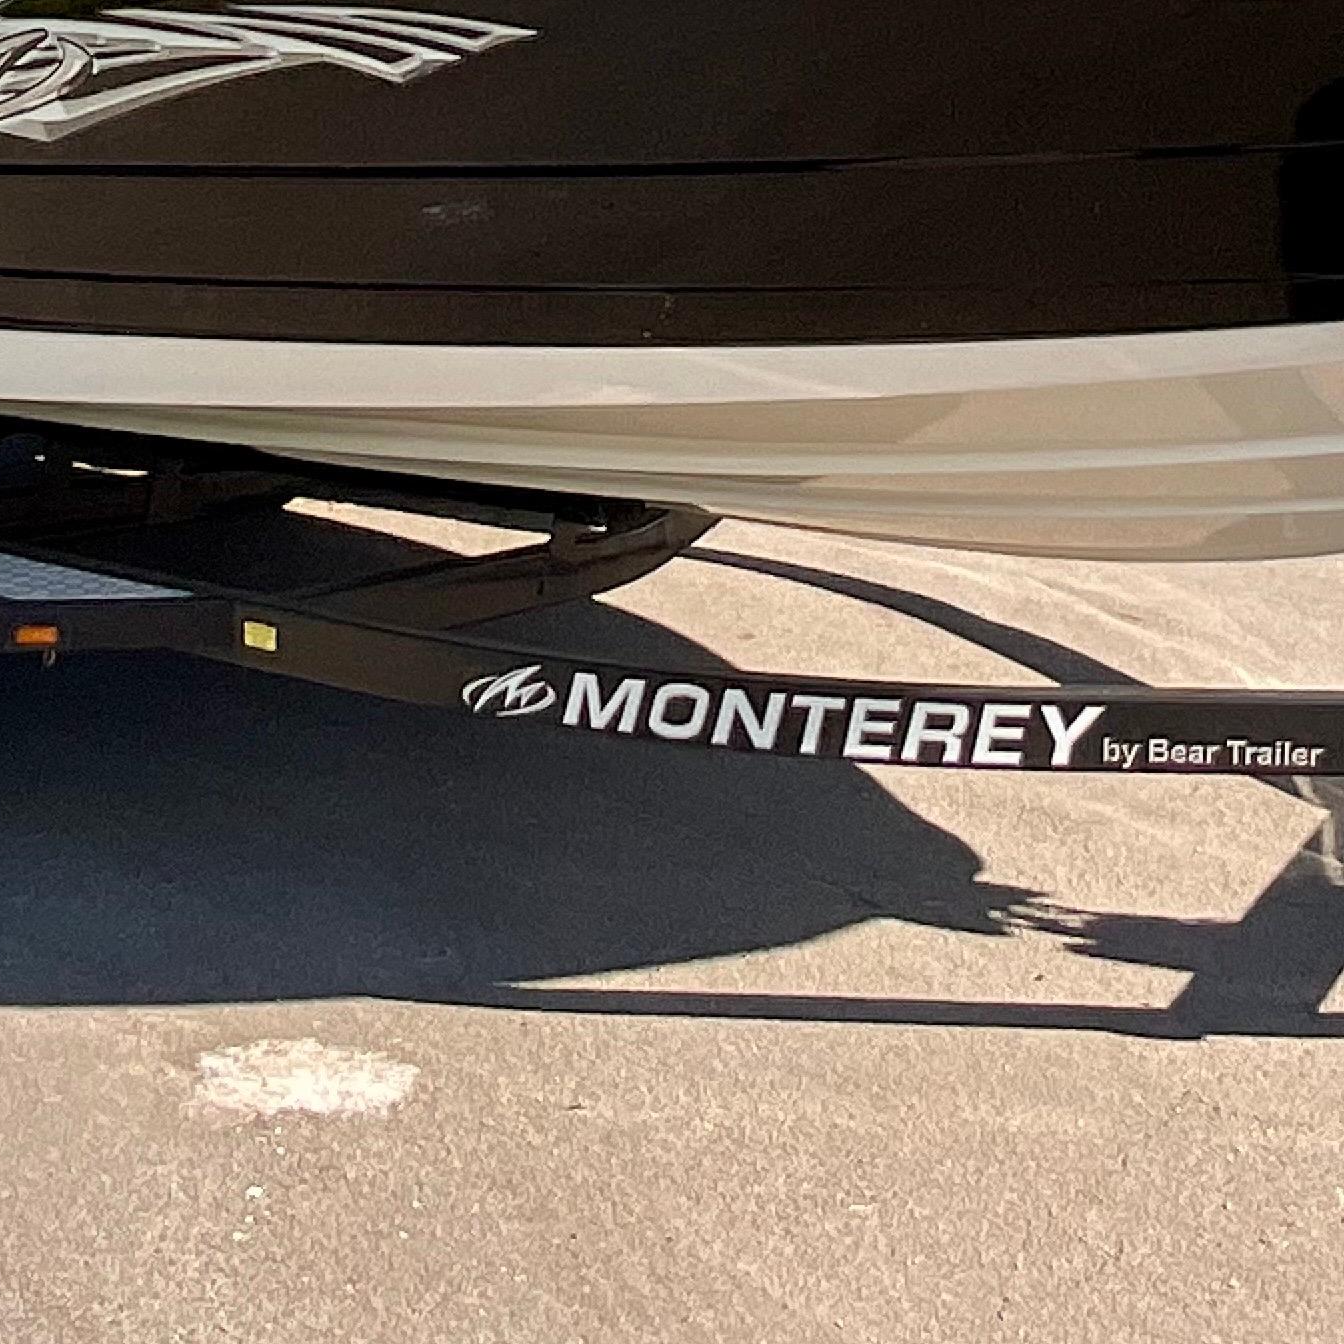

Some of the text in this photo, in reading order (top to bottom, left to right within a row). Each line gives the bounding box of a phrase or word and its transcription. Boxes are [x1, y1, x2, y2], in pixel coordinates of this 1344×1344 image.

[561, 671, 1326, 770] MONTEREY by Bear Trailer
